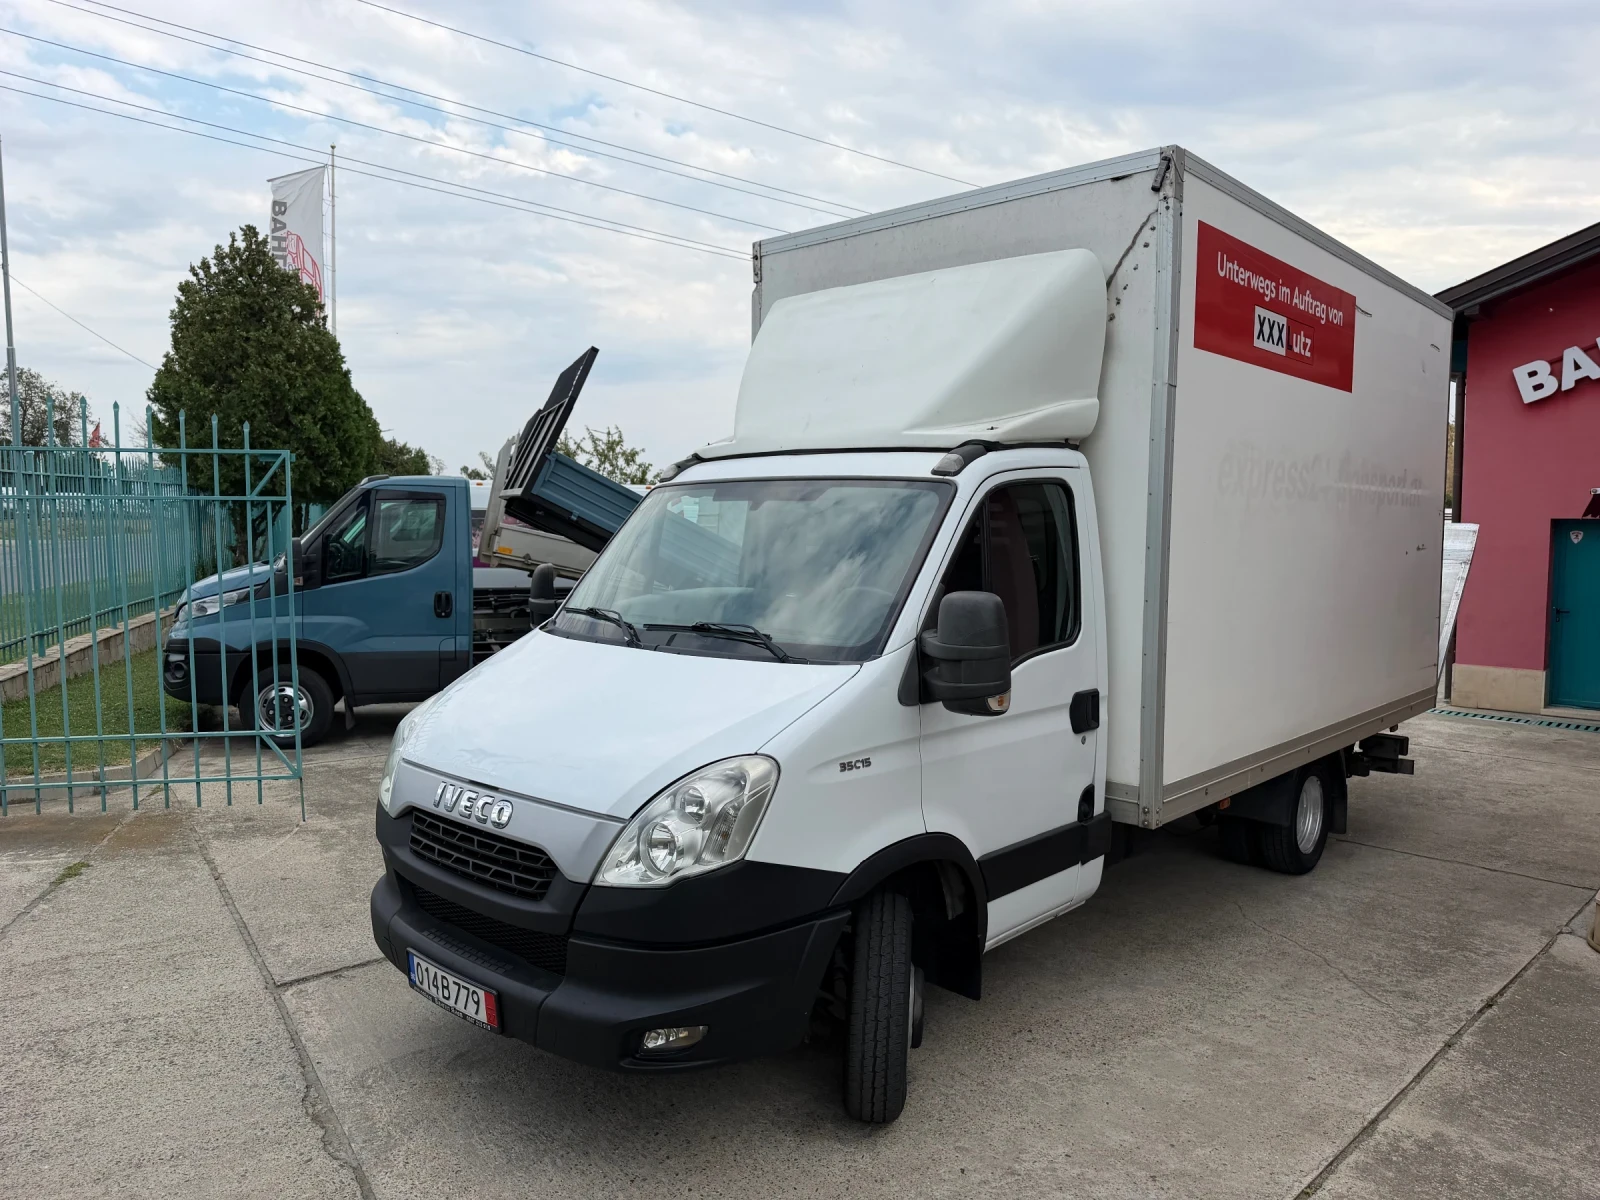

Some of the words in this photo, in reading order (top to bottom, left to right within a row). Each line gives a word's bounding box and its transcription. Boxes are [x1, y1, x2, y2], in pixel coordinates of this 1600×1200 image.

[1217, 251, 1276, 301] Unterwegs
[1278, 278, 1291, 305] im
[1292, 286, 1327, 325] Auftrag
[1328, 305, 1343, 326] von
[839, 756, 872, 773] 35C15
[432, 780, 514, 830] IVECO
[416, 961, 481, 1016] 014B779
